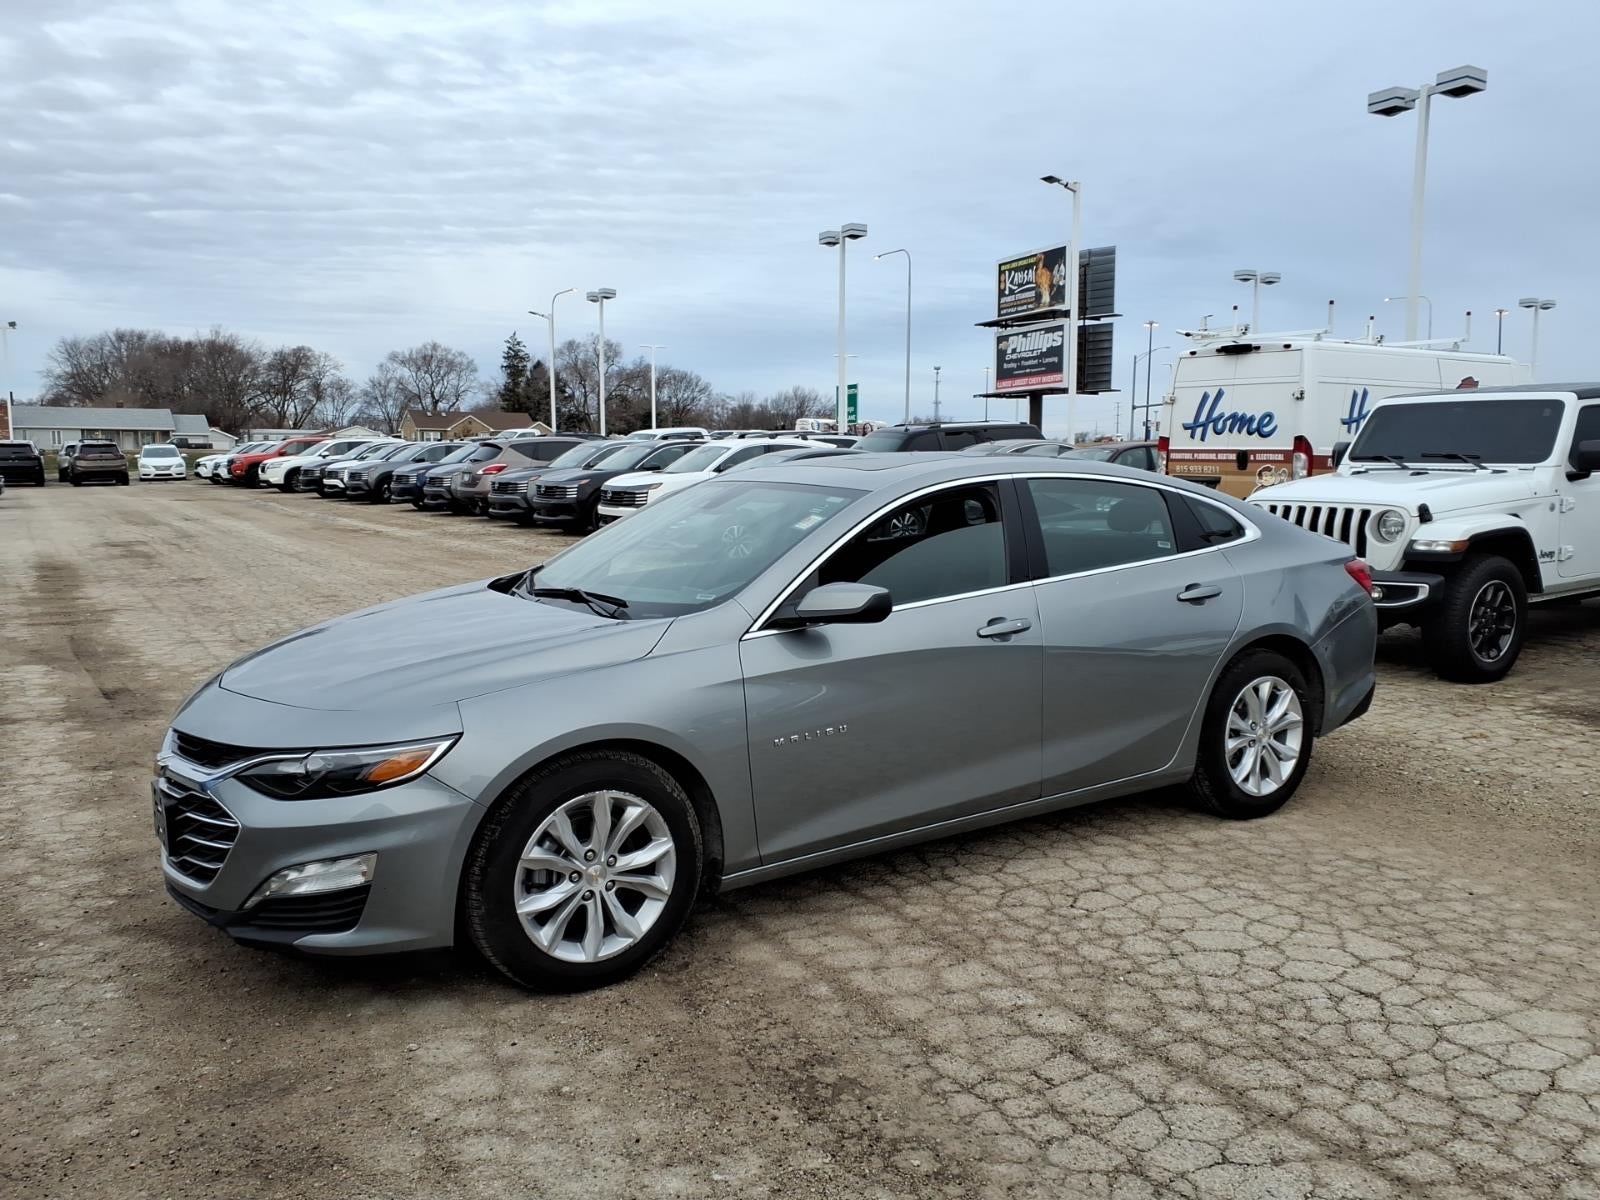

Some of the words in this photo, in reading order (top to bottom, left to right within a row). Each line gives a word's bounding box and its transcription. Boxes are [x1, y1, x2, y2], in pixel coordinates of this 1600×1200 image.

[1006, 331, 1063, 354] Phillips
[1005, 349, 1042, 361] CHEVROLET
[1182, 387, 1279, 442] Home
[1176, 465, 1188, 473] 815
[1539, 549, 1555, 560] Jeep
[773, 724, 848, 747] MALIBU
